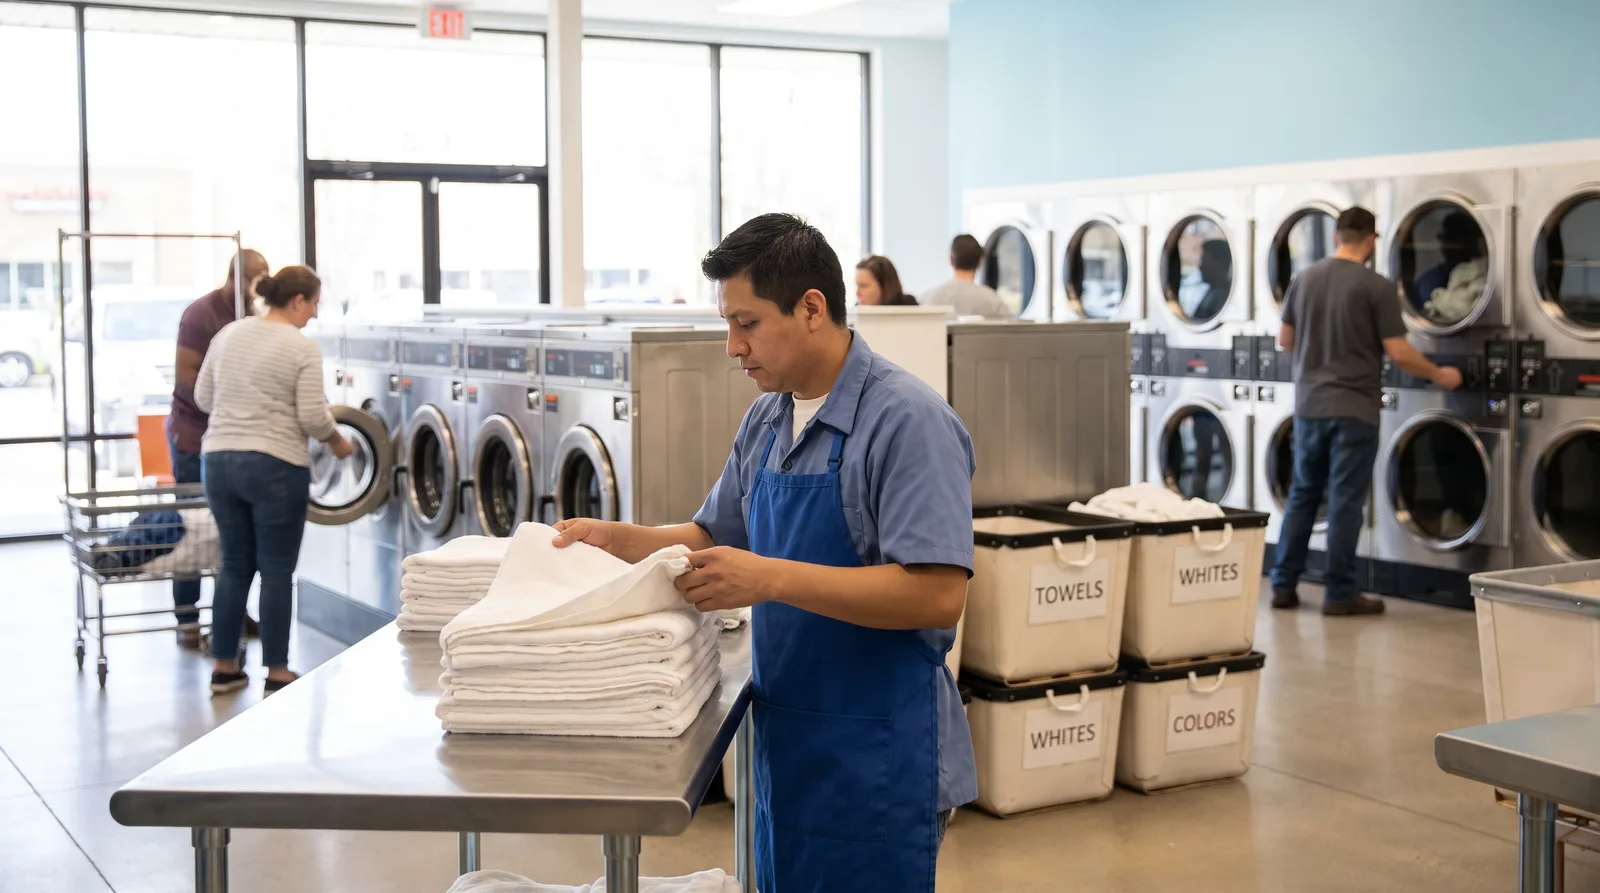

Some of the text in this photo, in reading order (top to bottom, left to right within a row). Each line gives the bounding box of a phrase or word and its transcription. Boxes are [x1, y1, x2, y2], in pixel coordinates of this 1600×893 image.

[1179, 563, 1238, 585] WHITES
[1035, 580, 1103, 605] TOWELS
[1173, 709, 1236, 733] COLORS
[1030, 723, 1096, 749] WHITES
